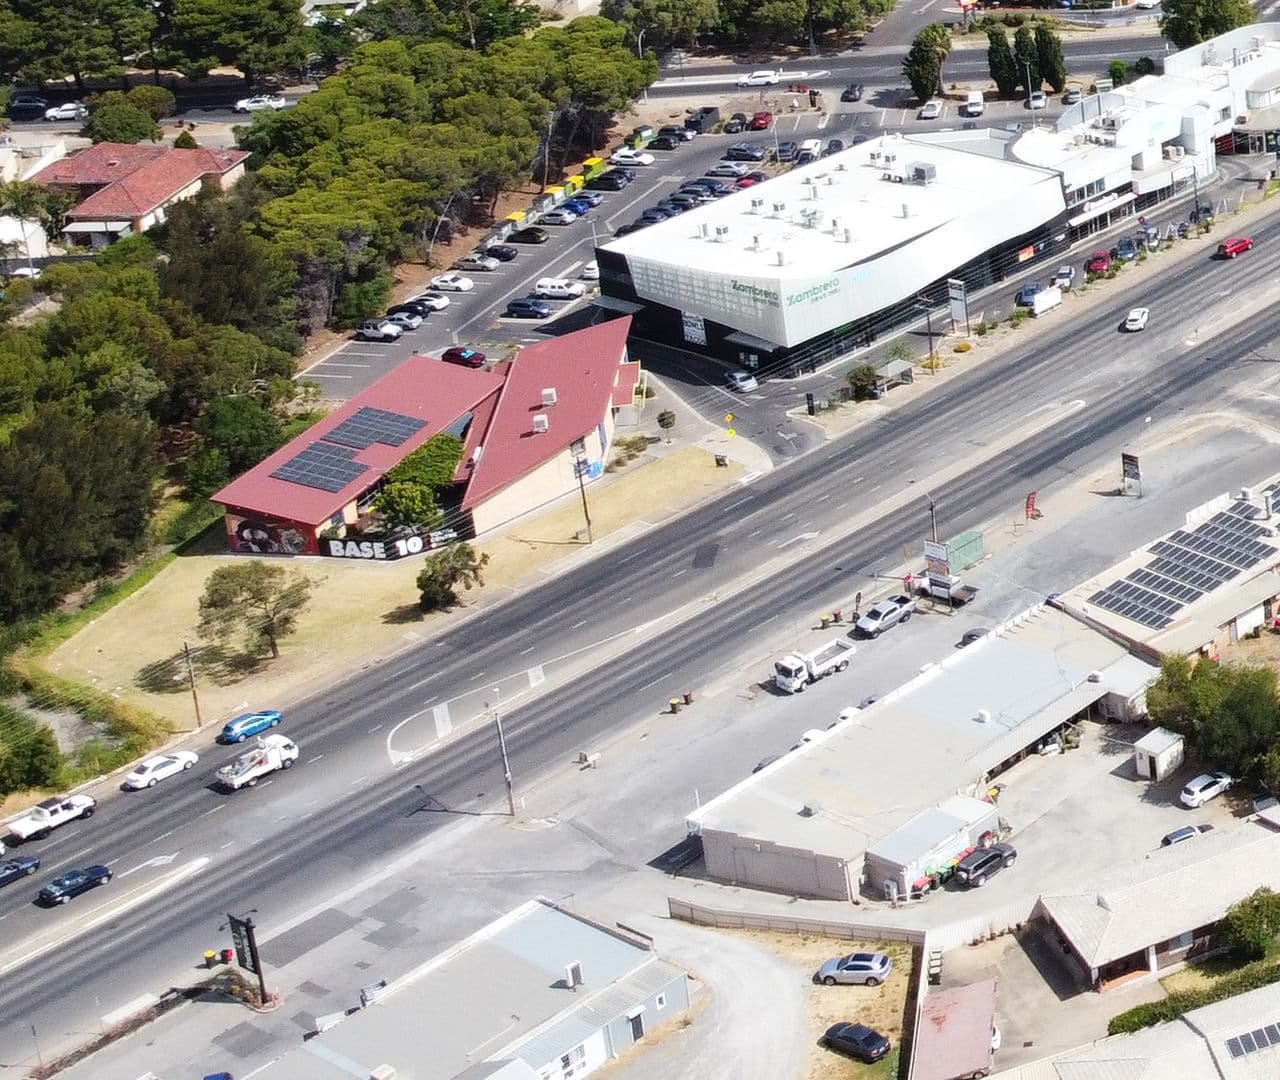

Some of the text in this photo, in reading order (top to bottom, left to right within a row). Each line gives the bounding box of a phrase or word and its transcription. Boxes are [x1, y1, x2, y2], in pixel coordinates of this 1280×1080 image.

[731, 279, 779, 300] Zambrero
[786, 278, 840, 306] Zambrero
[329, 536, 423, 559] BASE 10
